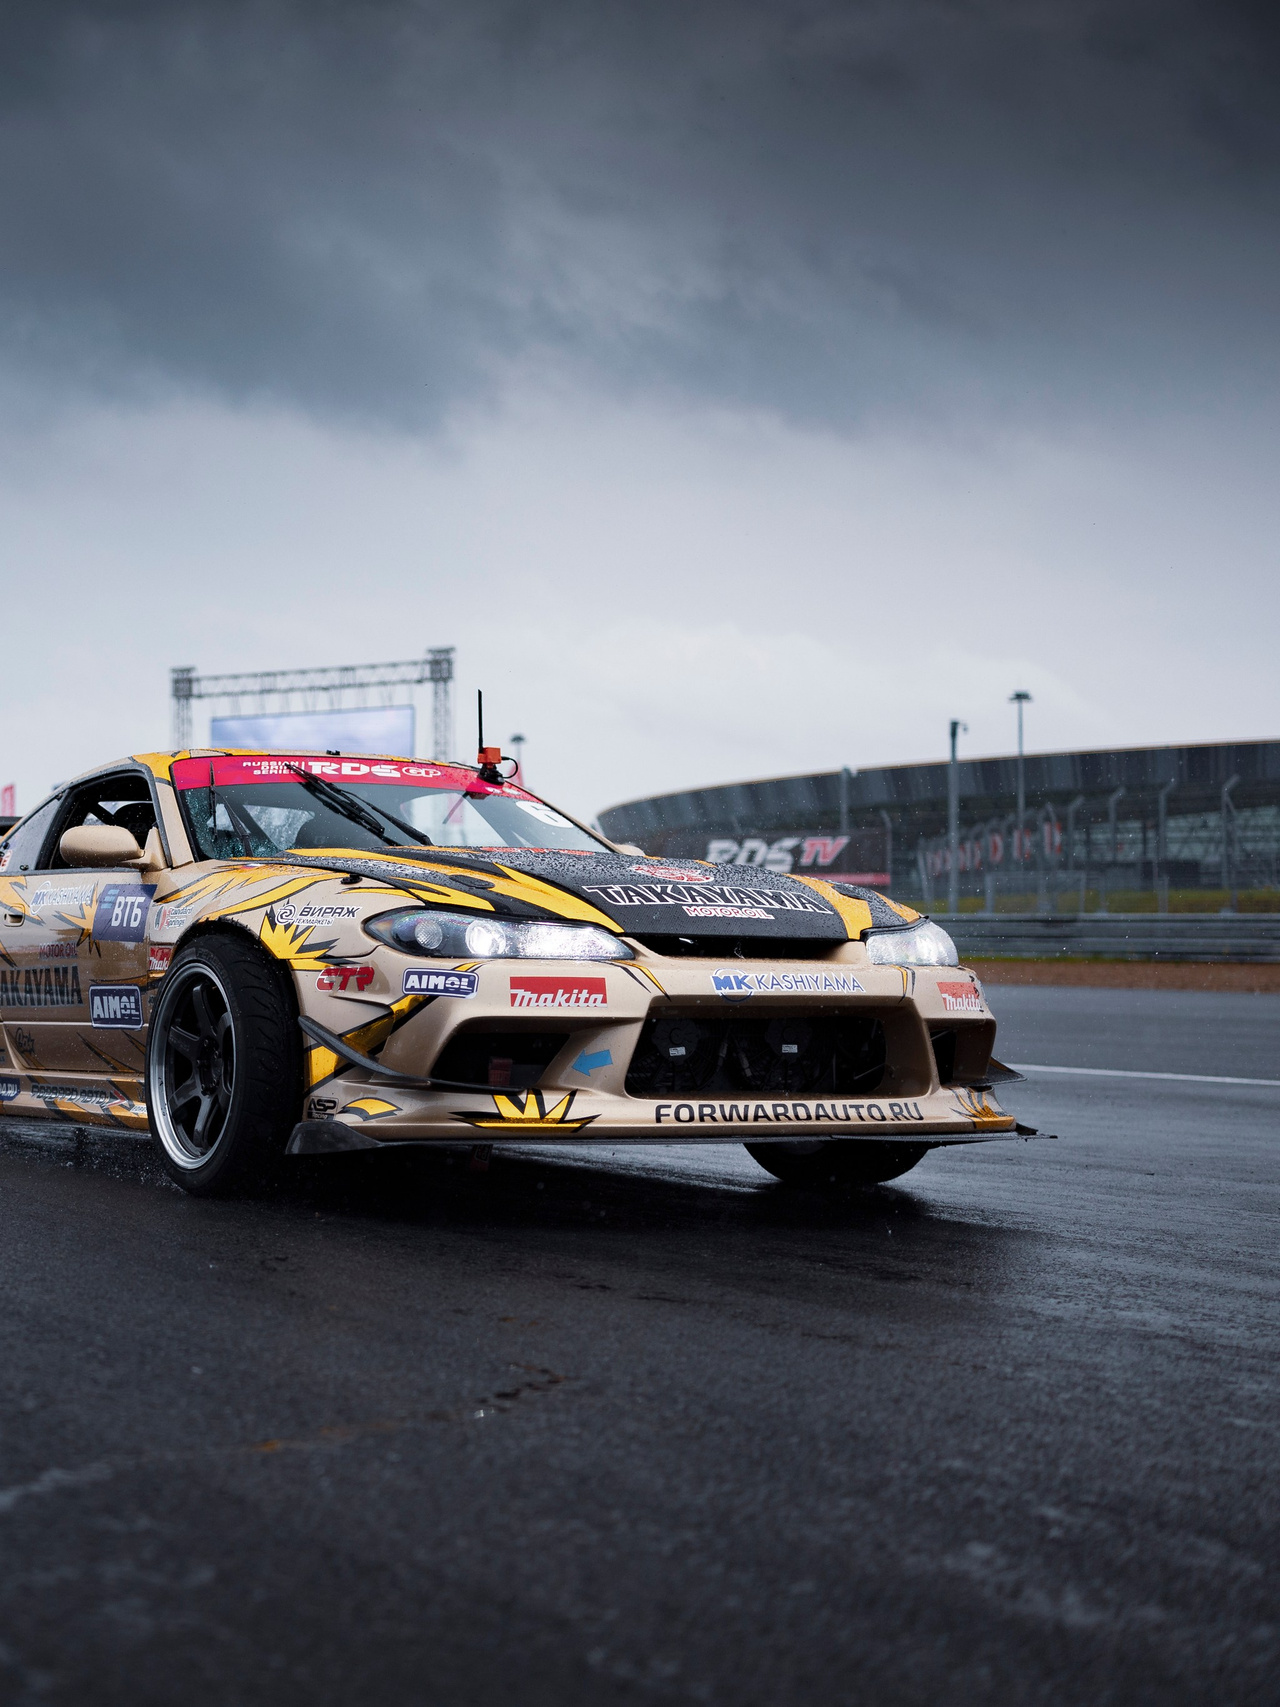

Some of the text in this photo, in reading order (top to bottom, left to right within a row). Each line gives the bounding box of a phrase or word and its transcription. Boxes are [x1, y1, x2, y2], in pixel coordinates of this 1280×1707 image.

[308, 761, 401, 778] RDS
[799, 836, 851, 866] TV
[582, 884, 833, 914] TAKAYAMA
[111, 896, 146, 927] ВТБ
[300, 906, 360, 918] ВИРАЖ
[682, 906, 775, 919] MOTOR OIL
[39, 943, 64, 958] MOTOR
[405, 974, 473, 990] AIMOL
[712, 973, 865, 992] MK KASHIYAMA
[93, 996, 140, 1019] AIMOL
[655, 1102, 925, 1123] FORWARDAUTO.RU
